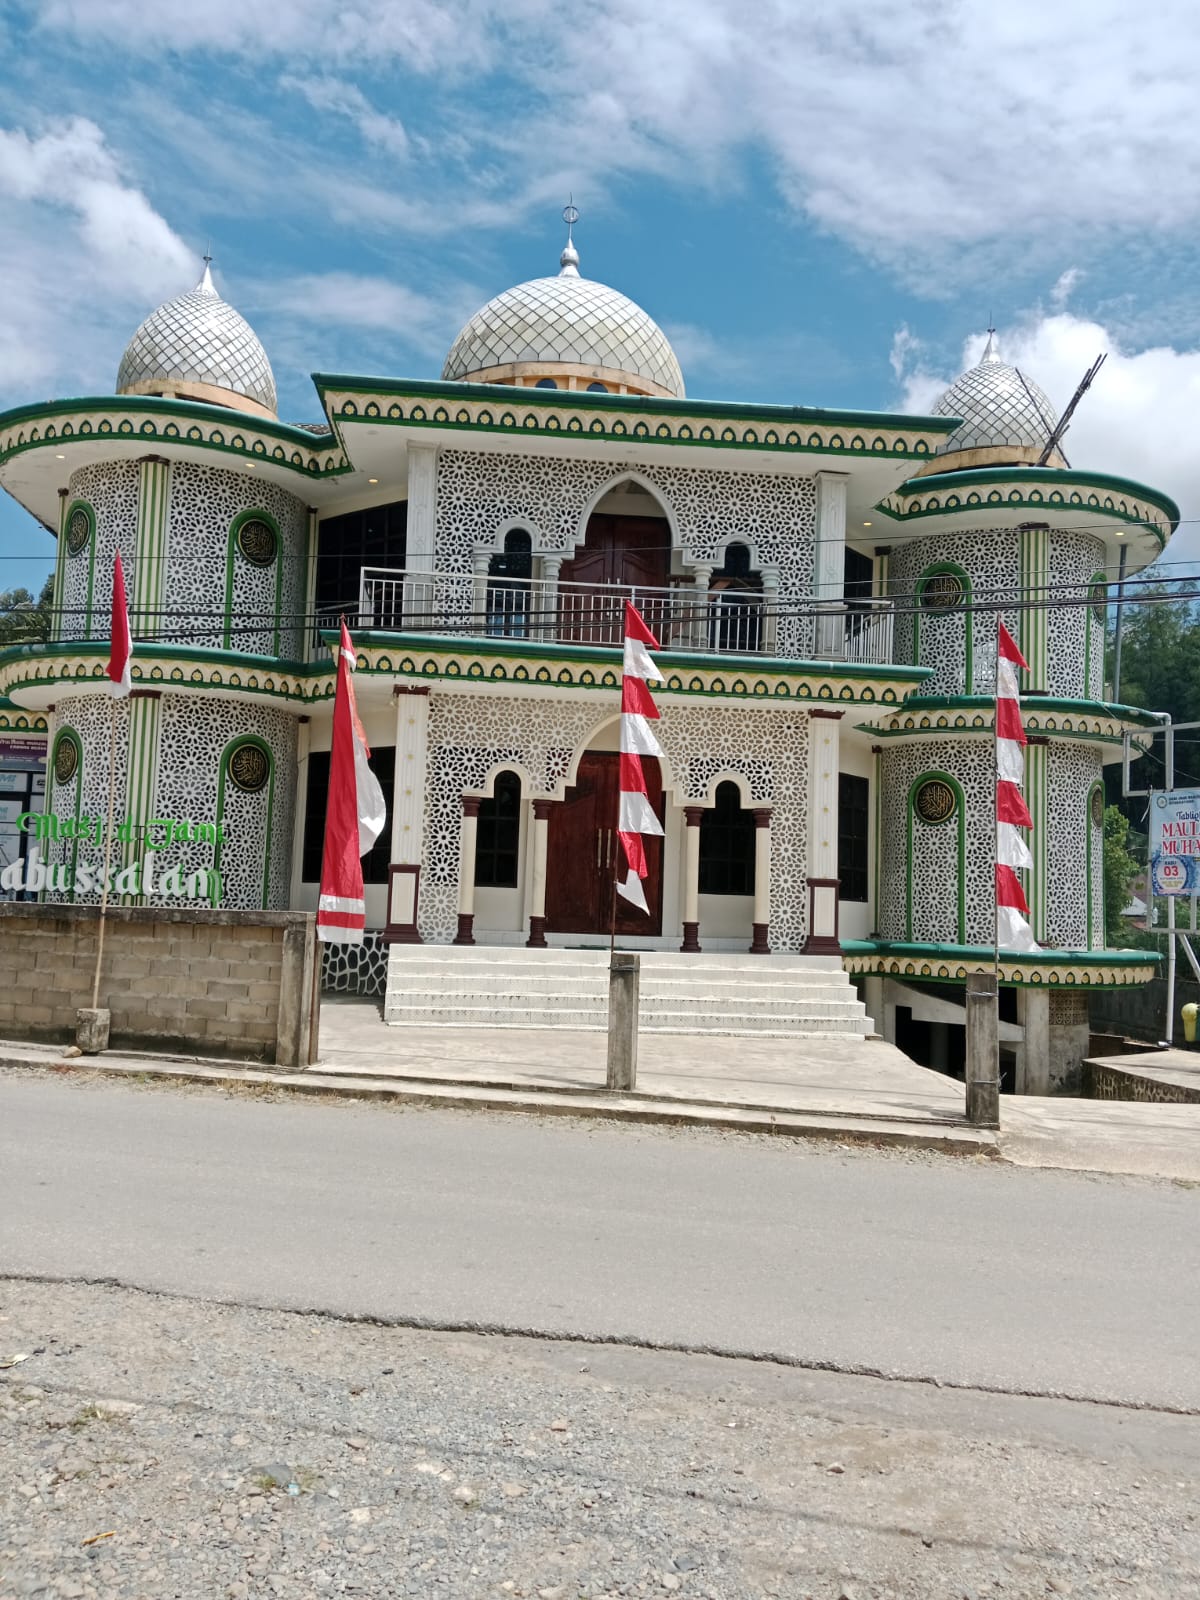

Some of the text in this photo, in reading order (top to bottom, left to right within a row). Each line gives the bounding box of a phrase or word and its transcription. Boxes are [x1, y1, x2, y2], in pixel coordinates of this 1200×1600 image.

[1176, 811, 1200, 822] Tablig
[15, 811, 136, 847] Masjd
[1162, 821, 1200, 837] MAUL
[1164, 866, 1178, 876] 03
